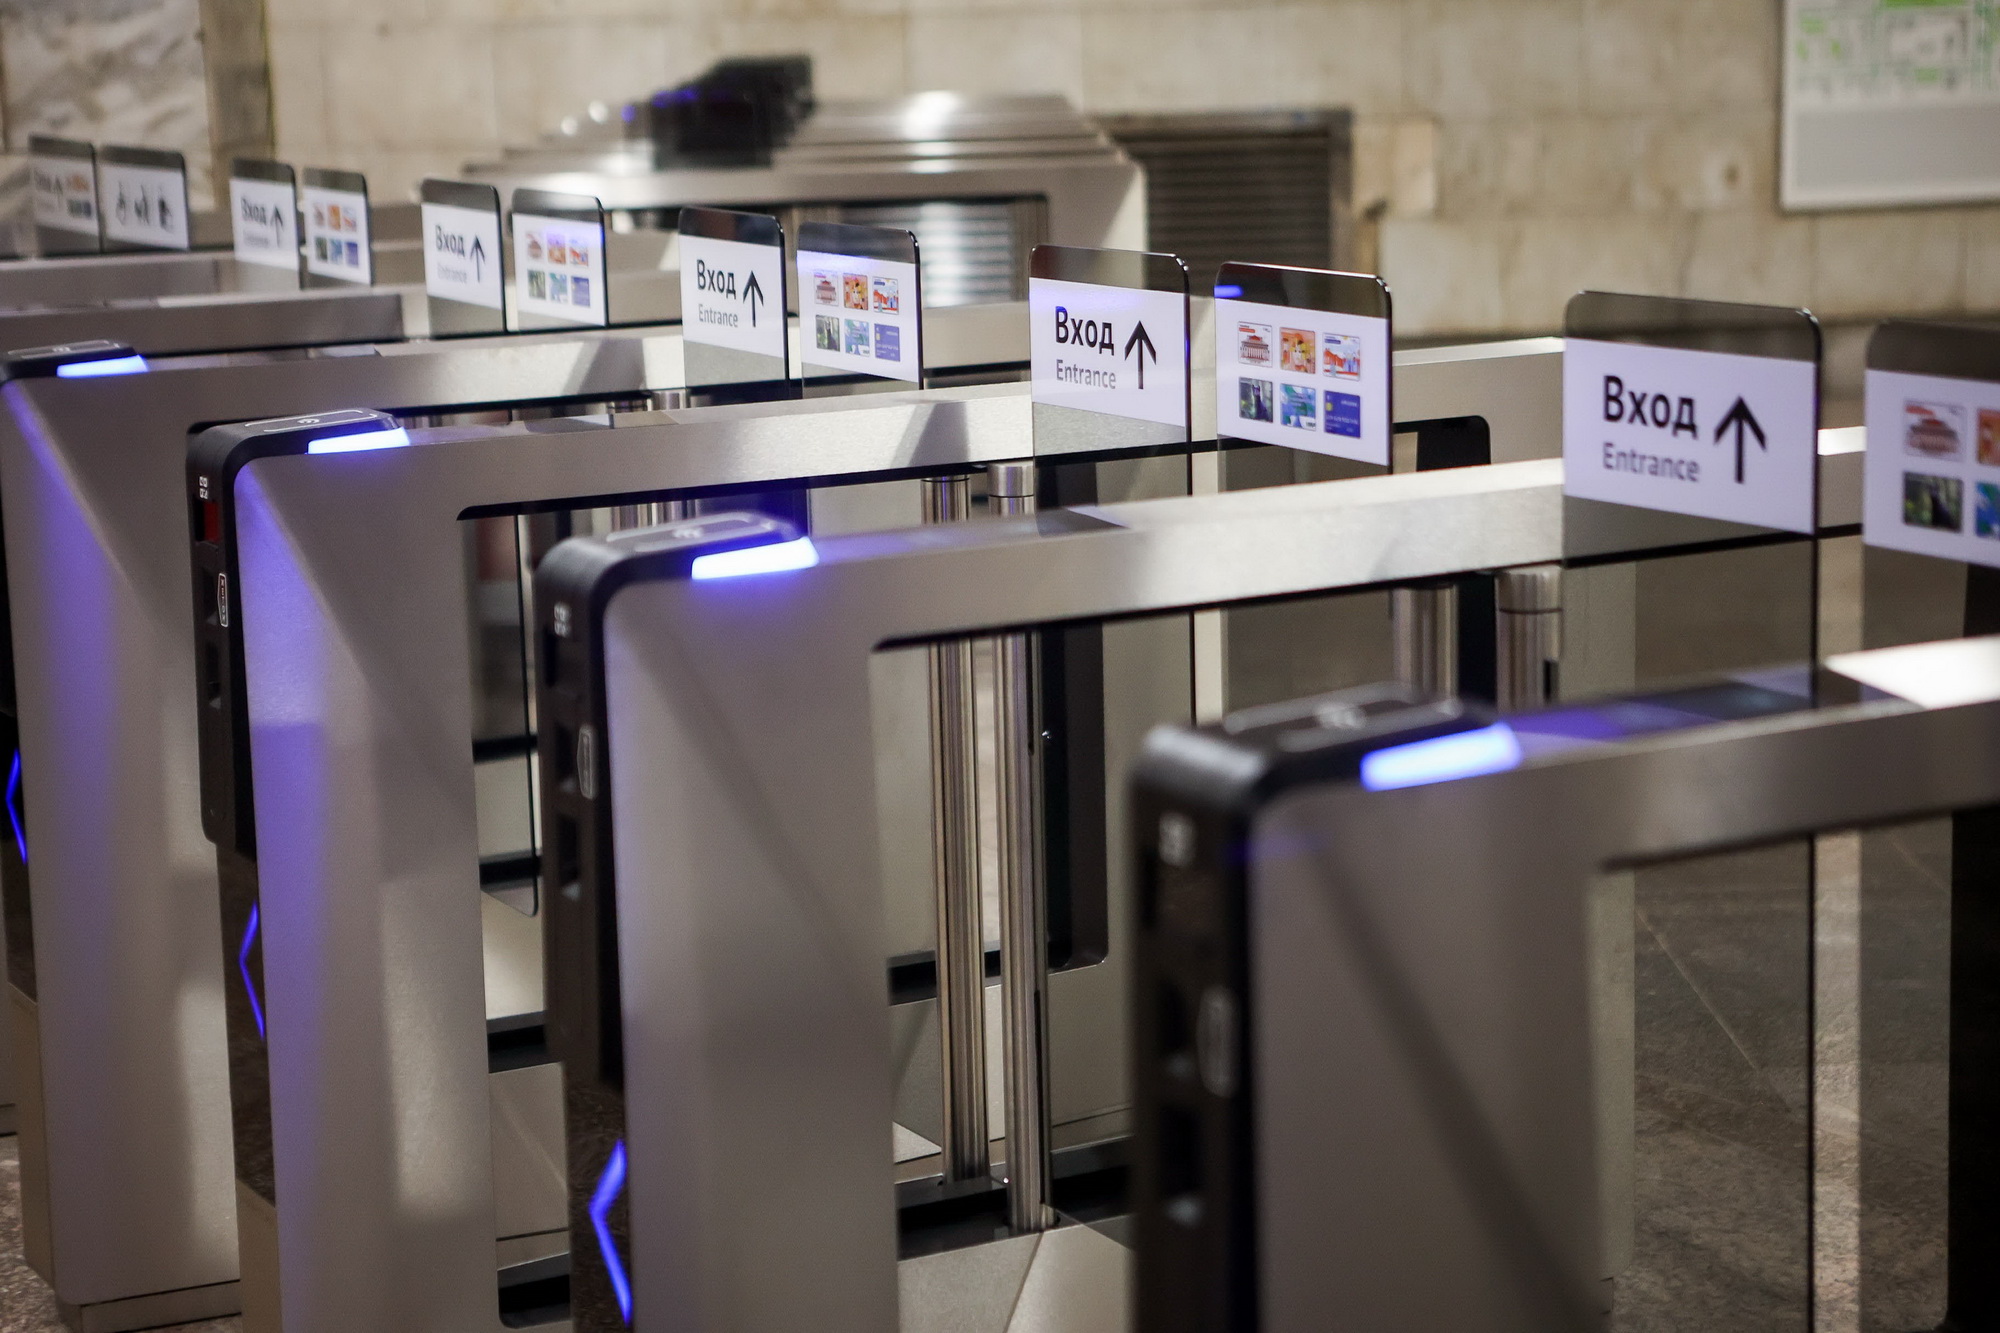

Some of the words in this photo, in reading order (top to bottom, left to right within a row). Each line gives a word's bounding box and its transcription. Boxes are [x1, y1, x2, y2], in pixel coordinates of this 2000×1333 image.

[435, 224, 465, 257] Вход
[697, 259, 736, 299] Вход
[698, 303, 739, 327] Entrance
[1056, 306, 1114, 354] Вход
[1056, 359, 1116, 389] Entrance
[1604, 375, 1697, 438] Вход
[1604, 442, 1700, 482] Entrance
